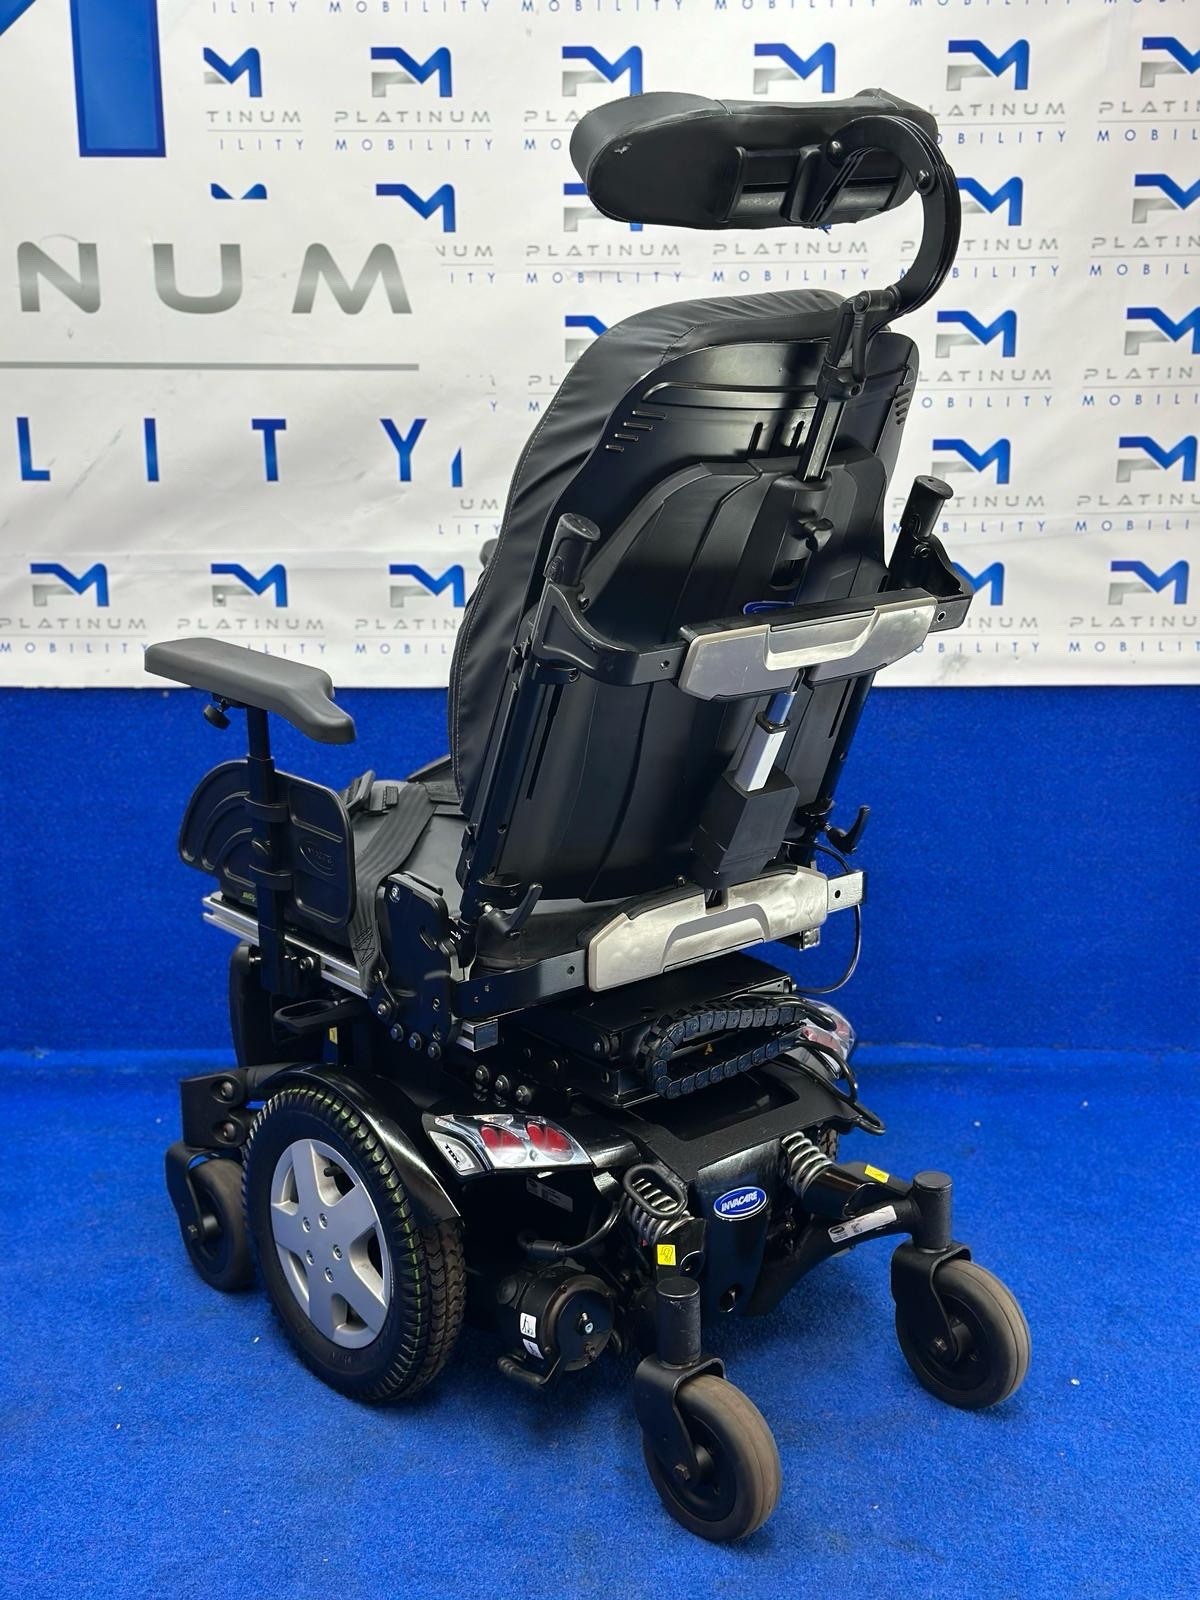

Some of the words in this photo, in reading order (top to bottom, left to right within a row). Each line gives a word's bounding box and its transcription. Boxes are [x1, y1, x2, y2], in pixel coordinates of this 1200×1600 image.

[329, 1, 490, 13] MOBILITY
[334, 110, 491, 124] PLATINUM
[335, 138, 493, 151] MOBILITY
[525, 244, 681, 258] PLATINUM
[712, 241, 868, 256] PLATINUM
[525, 272, 682, 284] MOBILITY
[712, 269, 870, 282] MOBILITY
[0, 618, 147, 630] PLATINUM
[176, 618, 325, 630] PLATINUM
[720, 1190, 758, 1213] INVACARE
